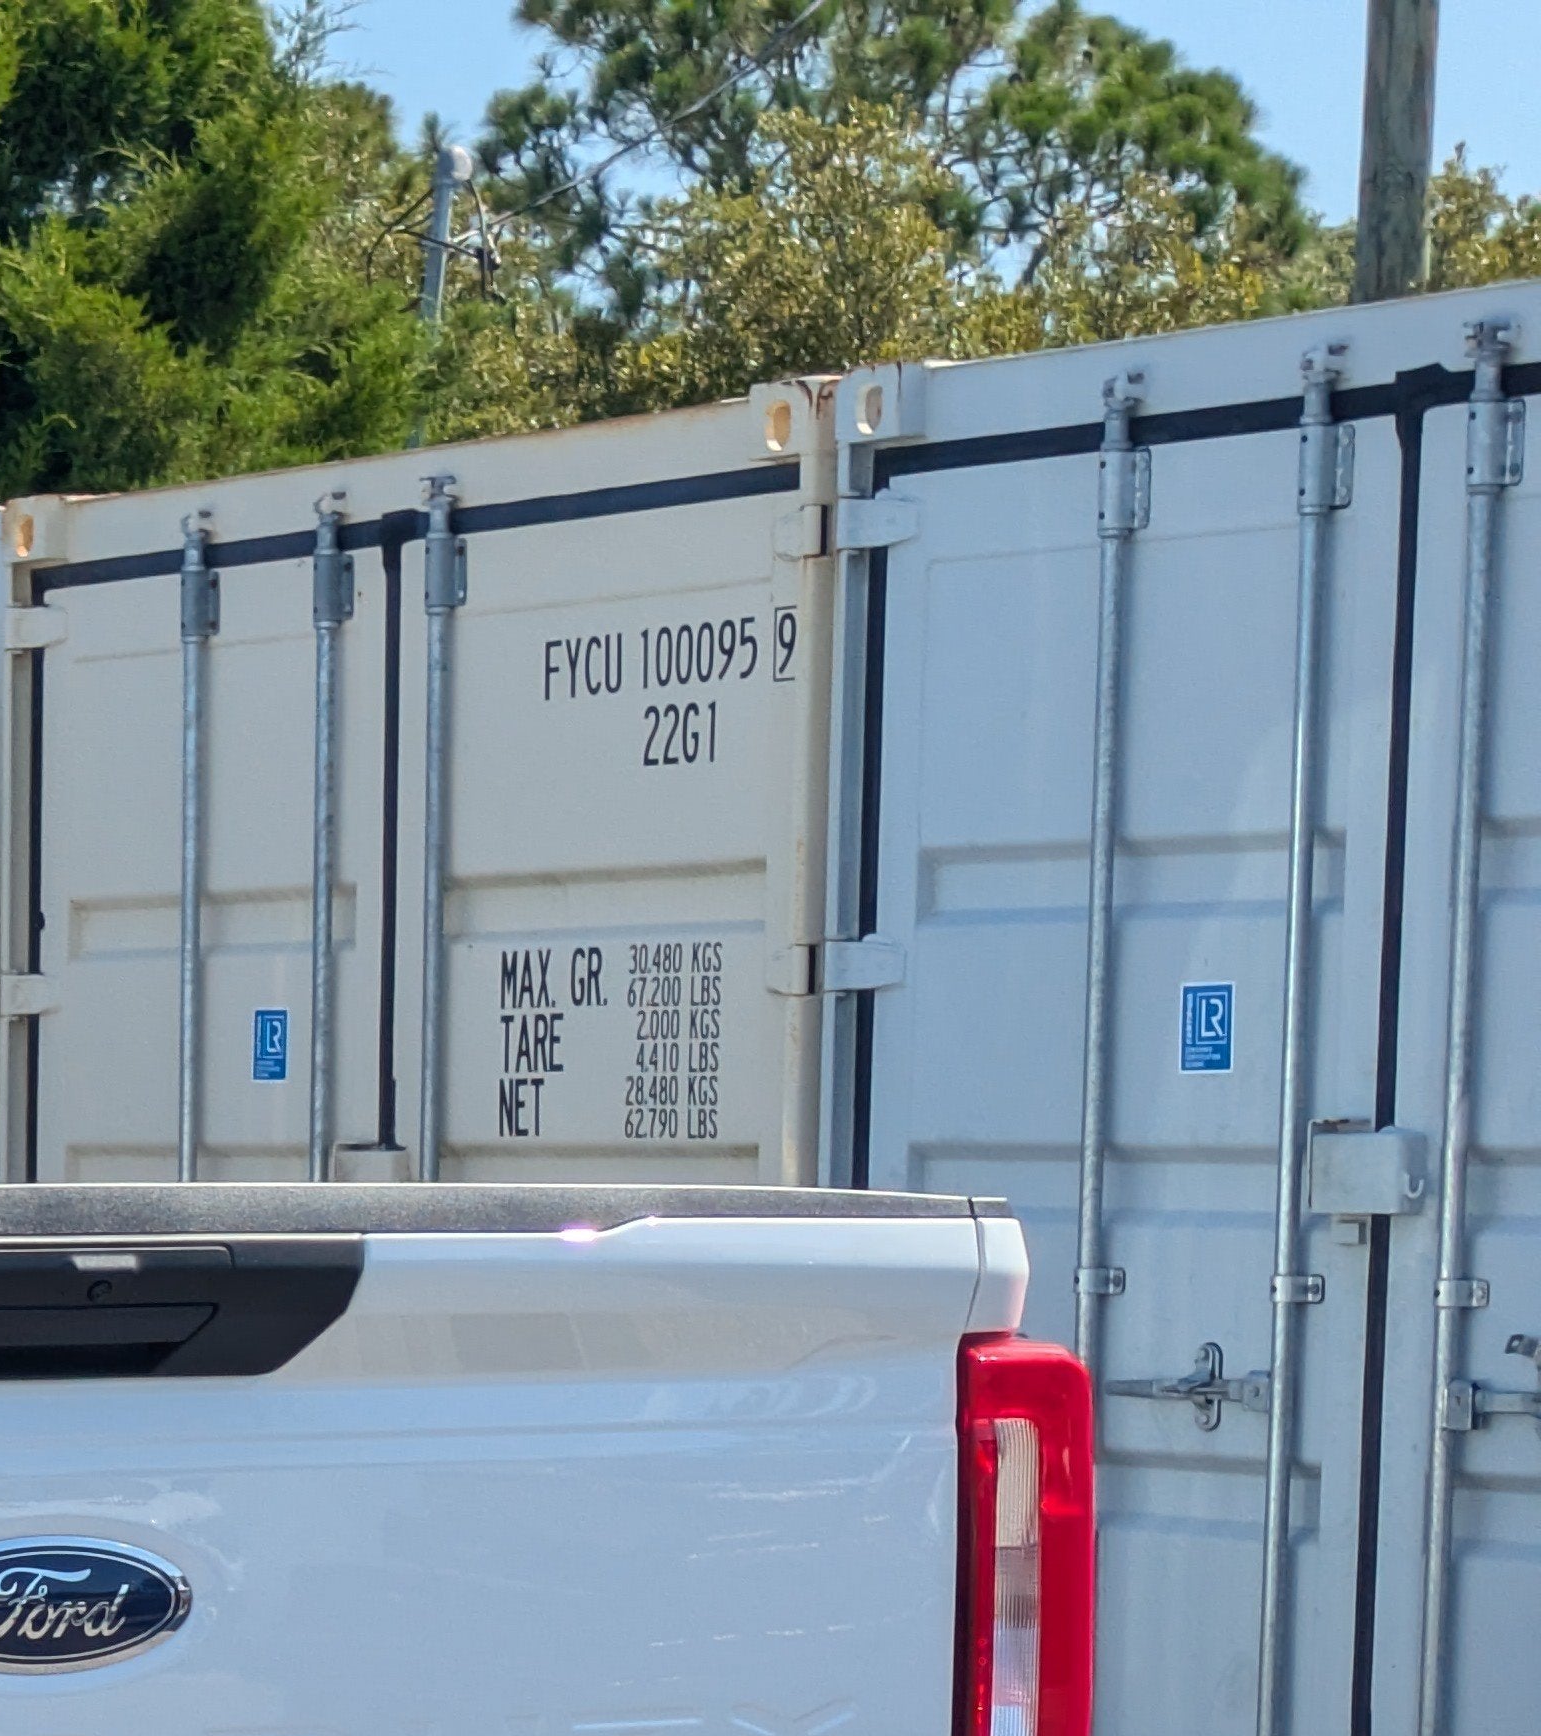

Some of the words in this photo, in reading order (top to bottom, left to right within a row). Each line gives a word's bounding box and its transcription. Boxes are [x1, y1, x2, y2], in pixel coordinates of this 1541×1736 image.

[545, 632, 622, 701] FYCU
[640, 616, 758, 690] 100095
[778, 612, 797, 675] 9
[643, 701, 716, 767] 22G1
[500, 949, 556, 1009] MAX.
[570, 947, 608, 1006] GR.
[691, 942, 723, 973] KGS
[690, 975, 721, 1006] LBS
[500, 1012, 564, 1074] TARE
[689, 1008, 721, 1039] KGS
[1200, 998, 1225, 1038] LR
[688, 1041, 720, 1073] LBS
[499, 1078, 545, 1137] NET
[687, 1075, 719, 1106] KGS
[687, 1108, 719, 1139] LBS
